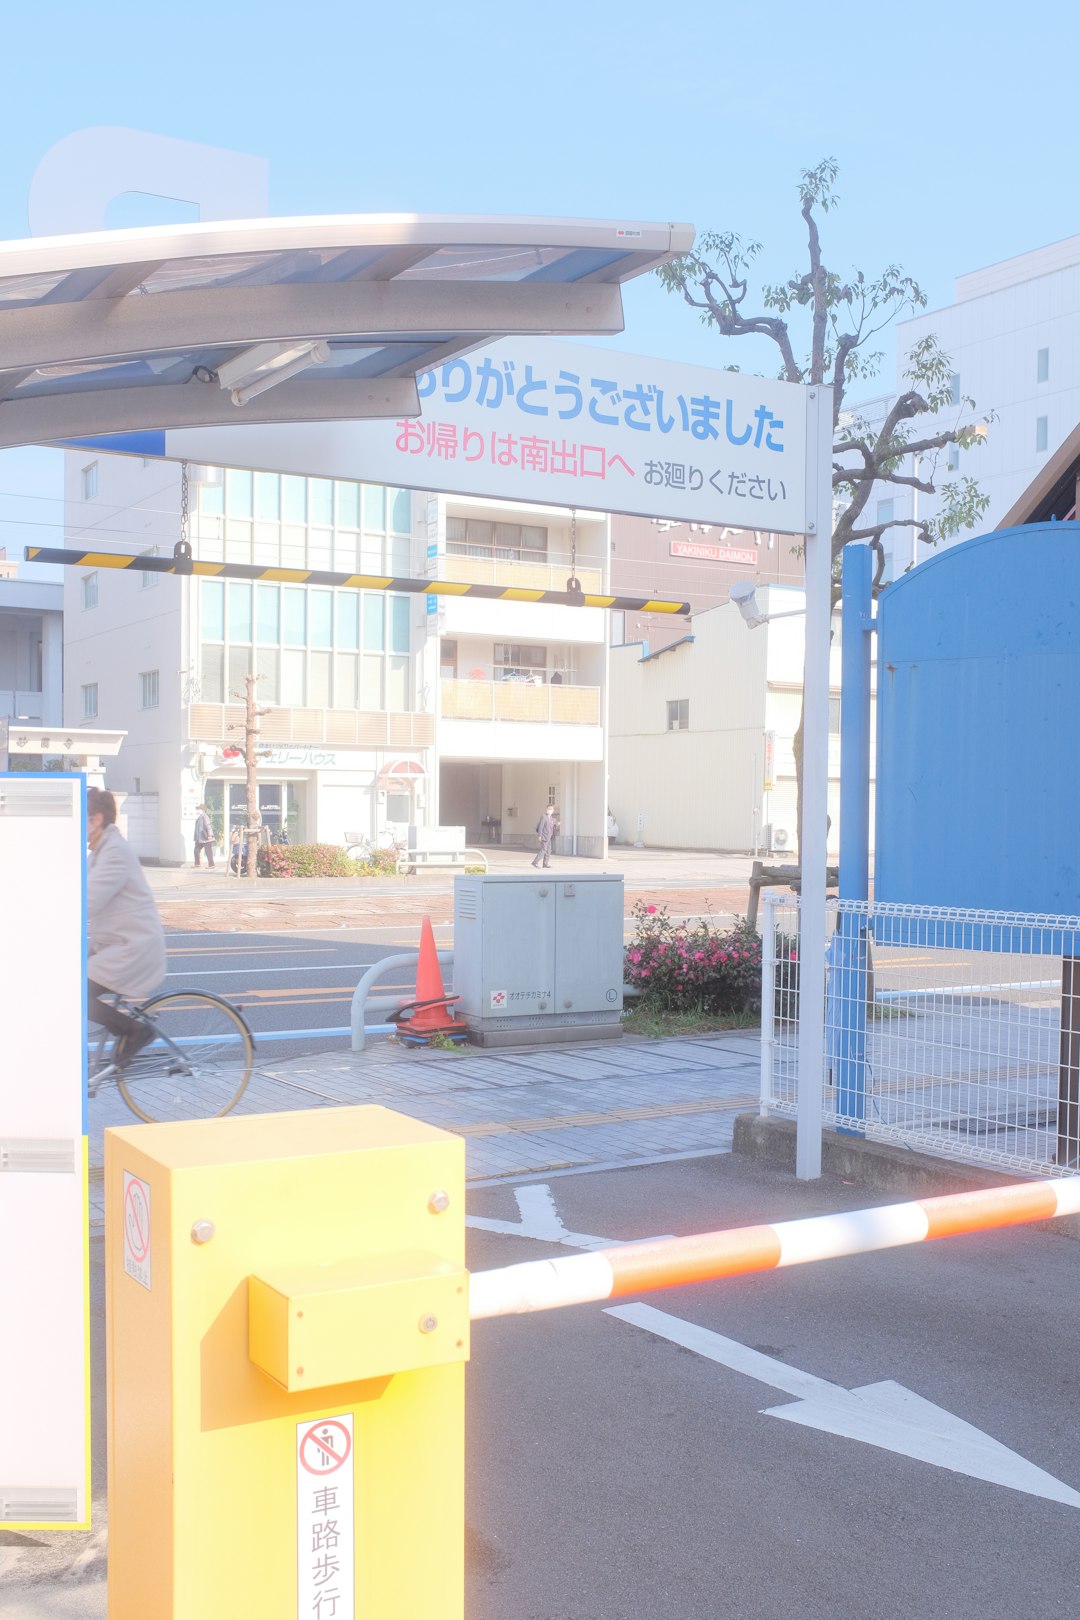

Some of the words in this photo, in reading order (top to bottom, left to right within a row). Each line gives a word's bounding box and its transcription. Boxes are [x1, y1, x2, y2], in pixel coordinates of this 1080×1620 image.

[395, 417, 636, 480] お帰りは南出口へ
[643, 459, 787, 502] お廻りください
[675, 544, 717, 558] YAKINIKU
[719, 548, 754, 562] DAIMON
[259, 750, 336, 766] ェリーハウス
[311, 1485, 341, 1620] 車路歩行
